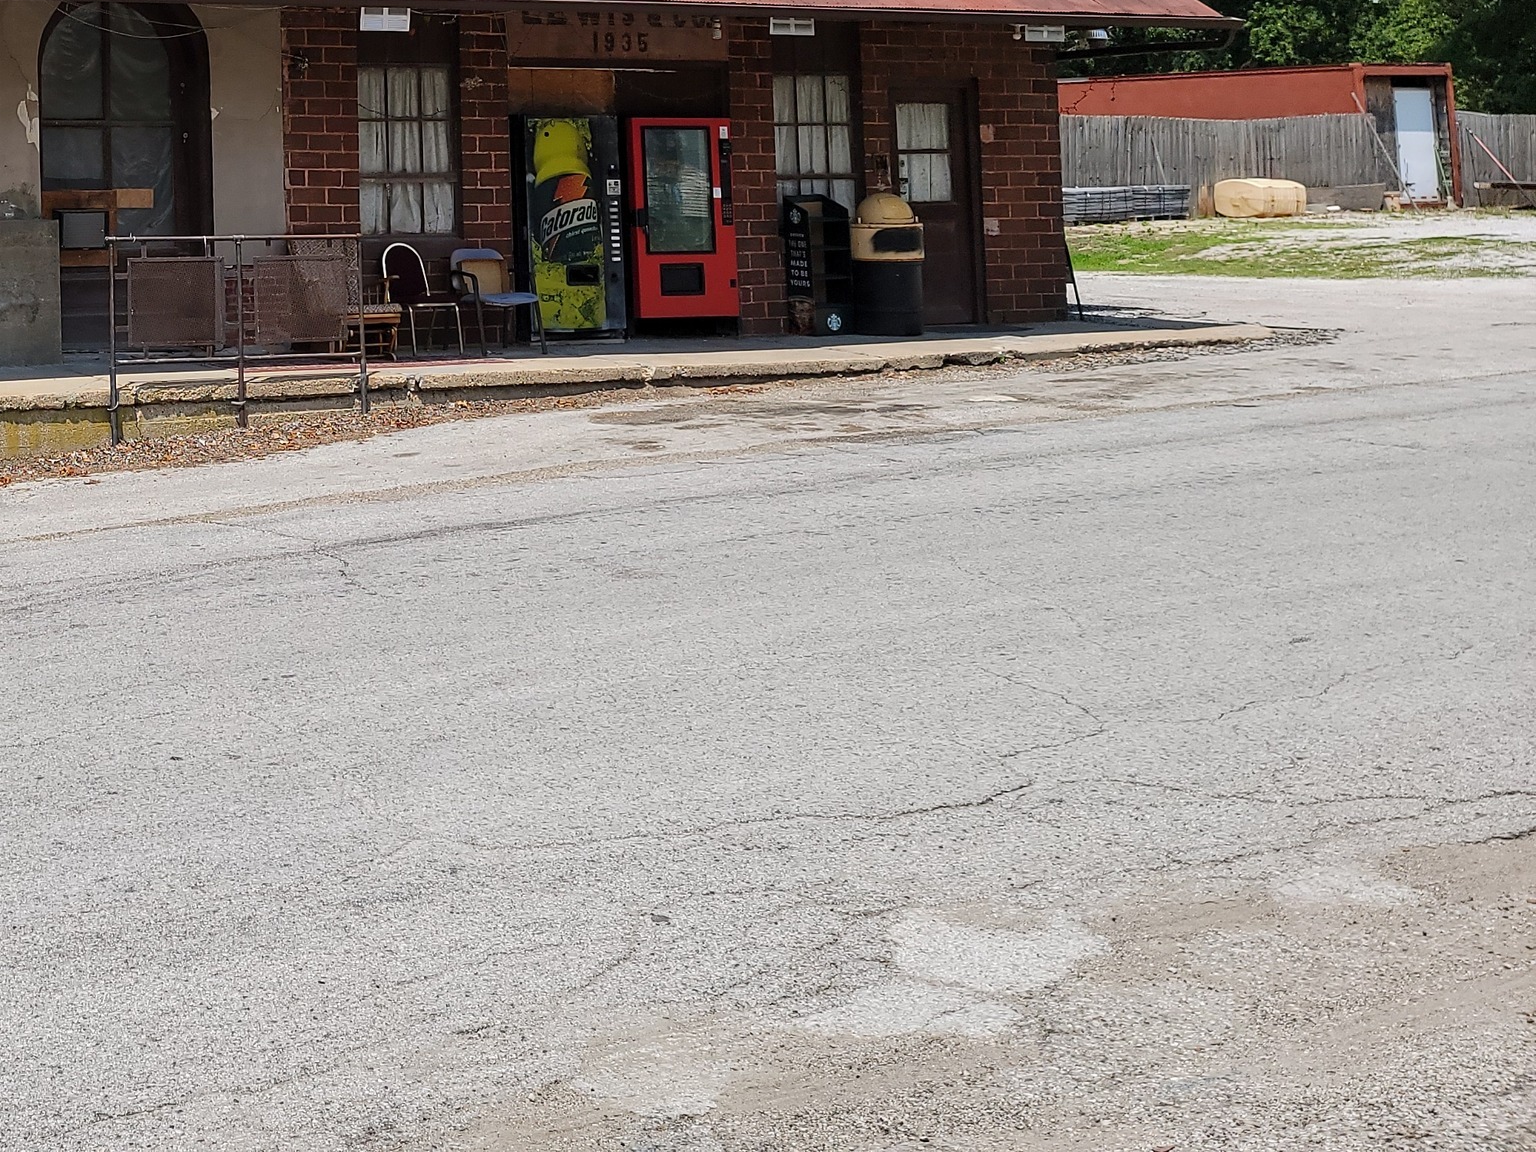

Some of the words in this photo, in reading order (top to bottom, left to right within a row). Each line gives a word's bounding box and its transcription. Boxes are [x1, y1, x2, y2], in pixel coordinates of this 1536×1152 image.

[592, 31, 649, 53] 1935
[541, 201, 598, 241] Gatorade
[790, 259, 808, 268] MADE
[791, 269, 800, 277] TO
[800, 270, 808, 278] BE
[790, 279, 811, 288] YOURS
